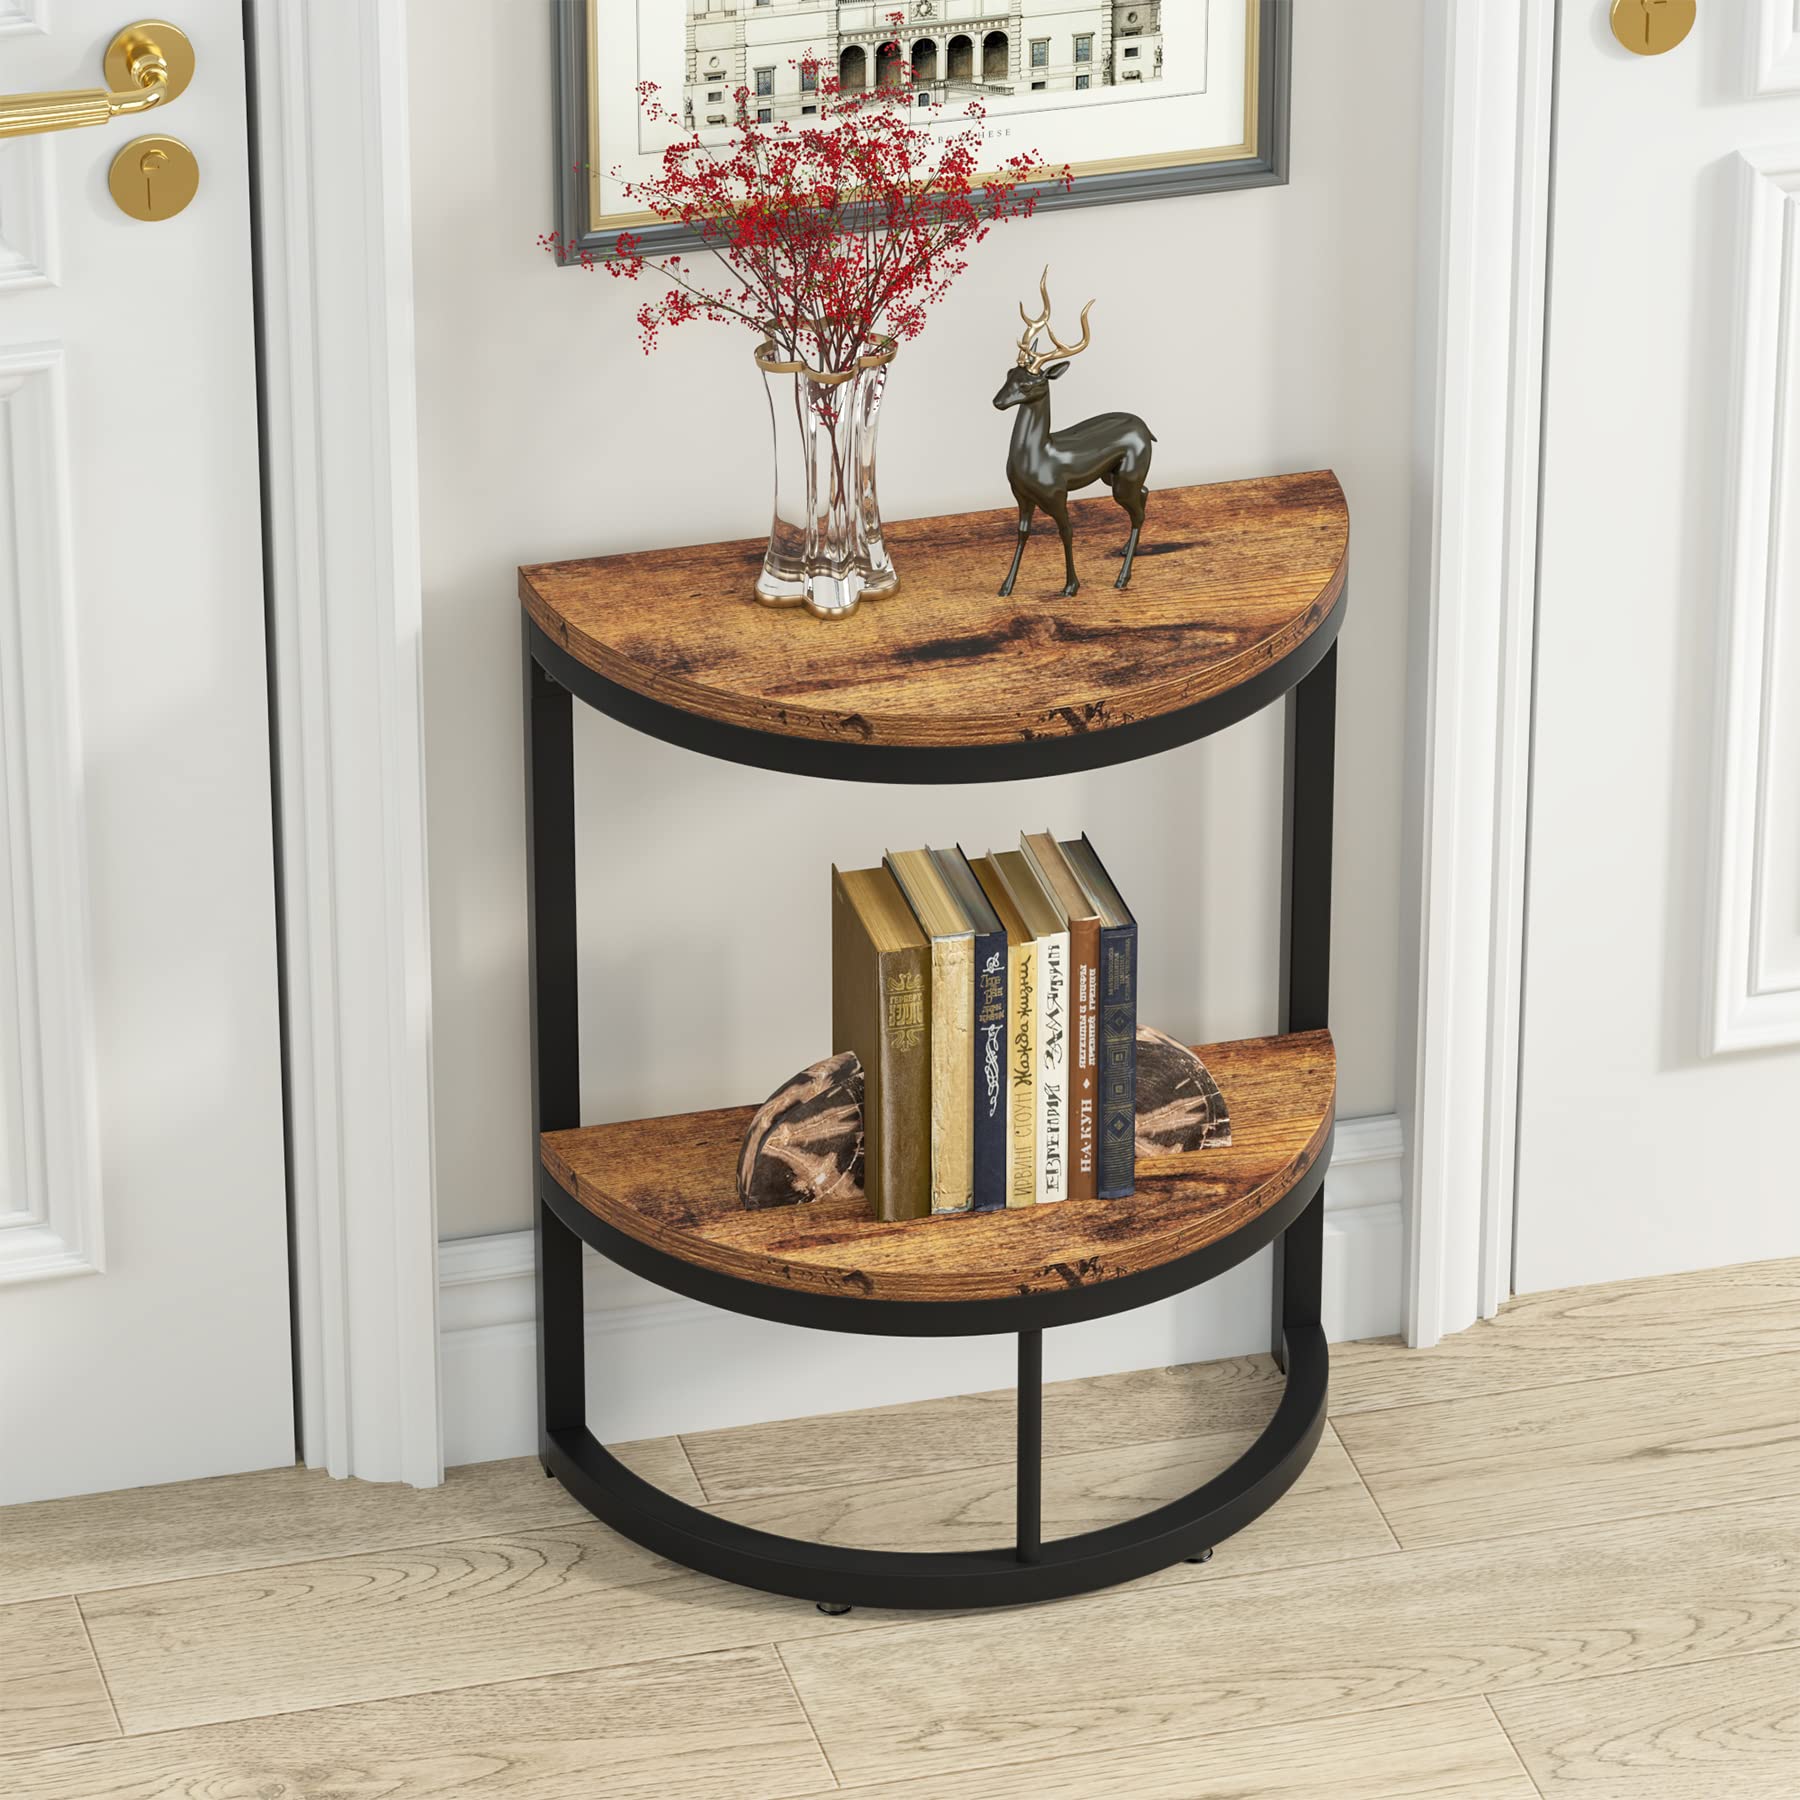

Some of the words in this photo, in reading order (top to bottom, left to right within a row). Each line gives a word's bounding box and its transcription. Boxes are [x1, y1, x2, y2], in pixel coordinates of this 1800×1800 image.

[1016, 954, 1033, 1019] жизни
[1014, 1020, 1033, 1087] Жажда
[1013, 1091, 1033, 1138] СТОУН
[1012, 1143, 1033, 1197] ИРВИНГ
